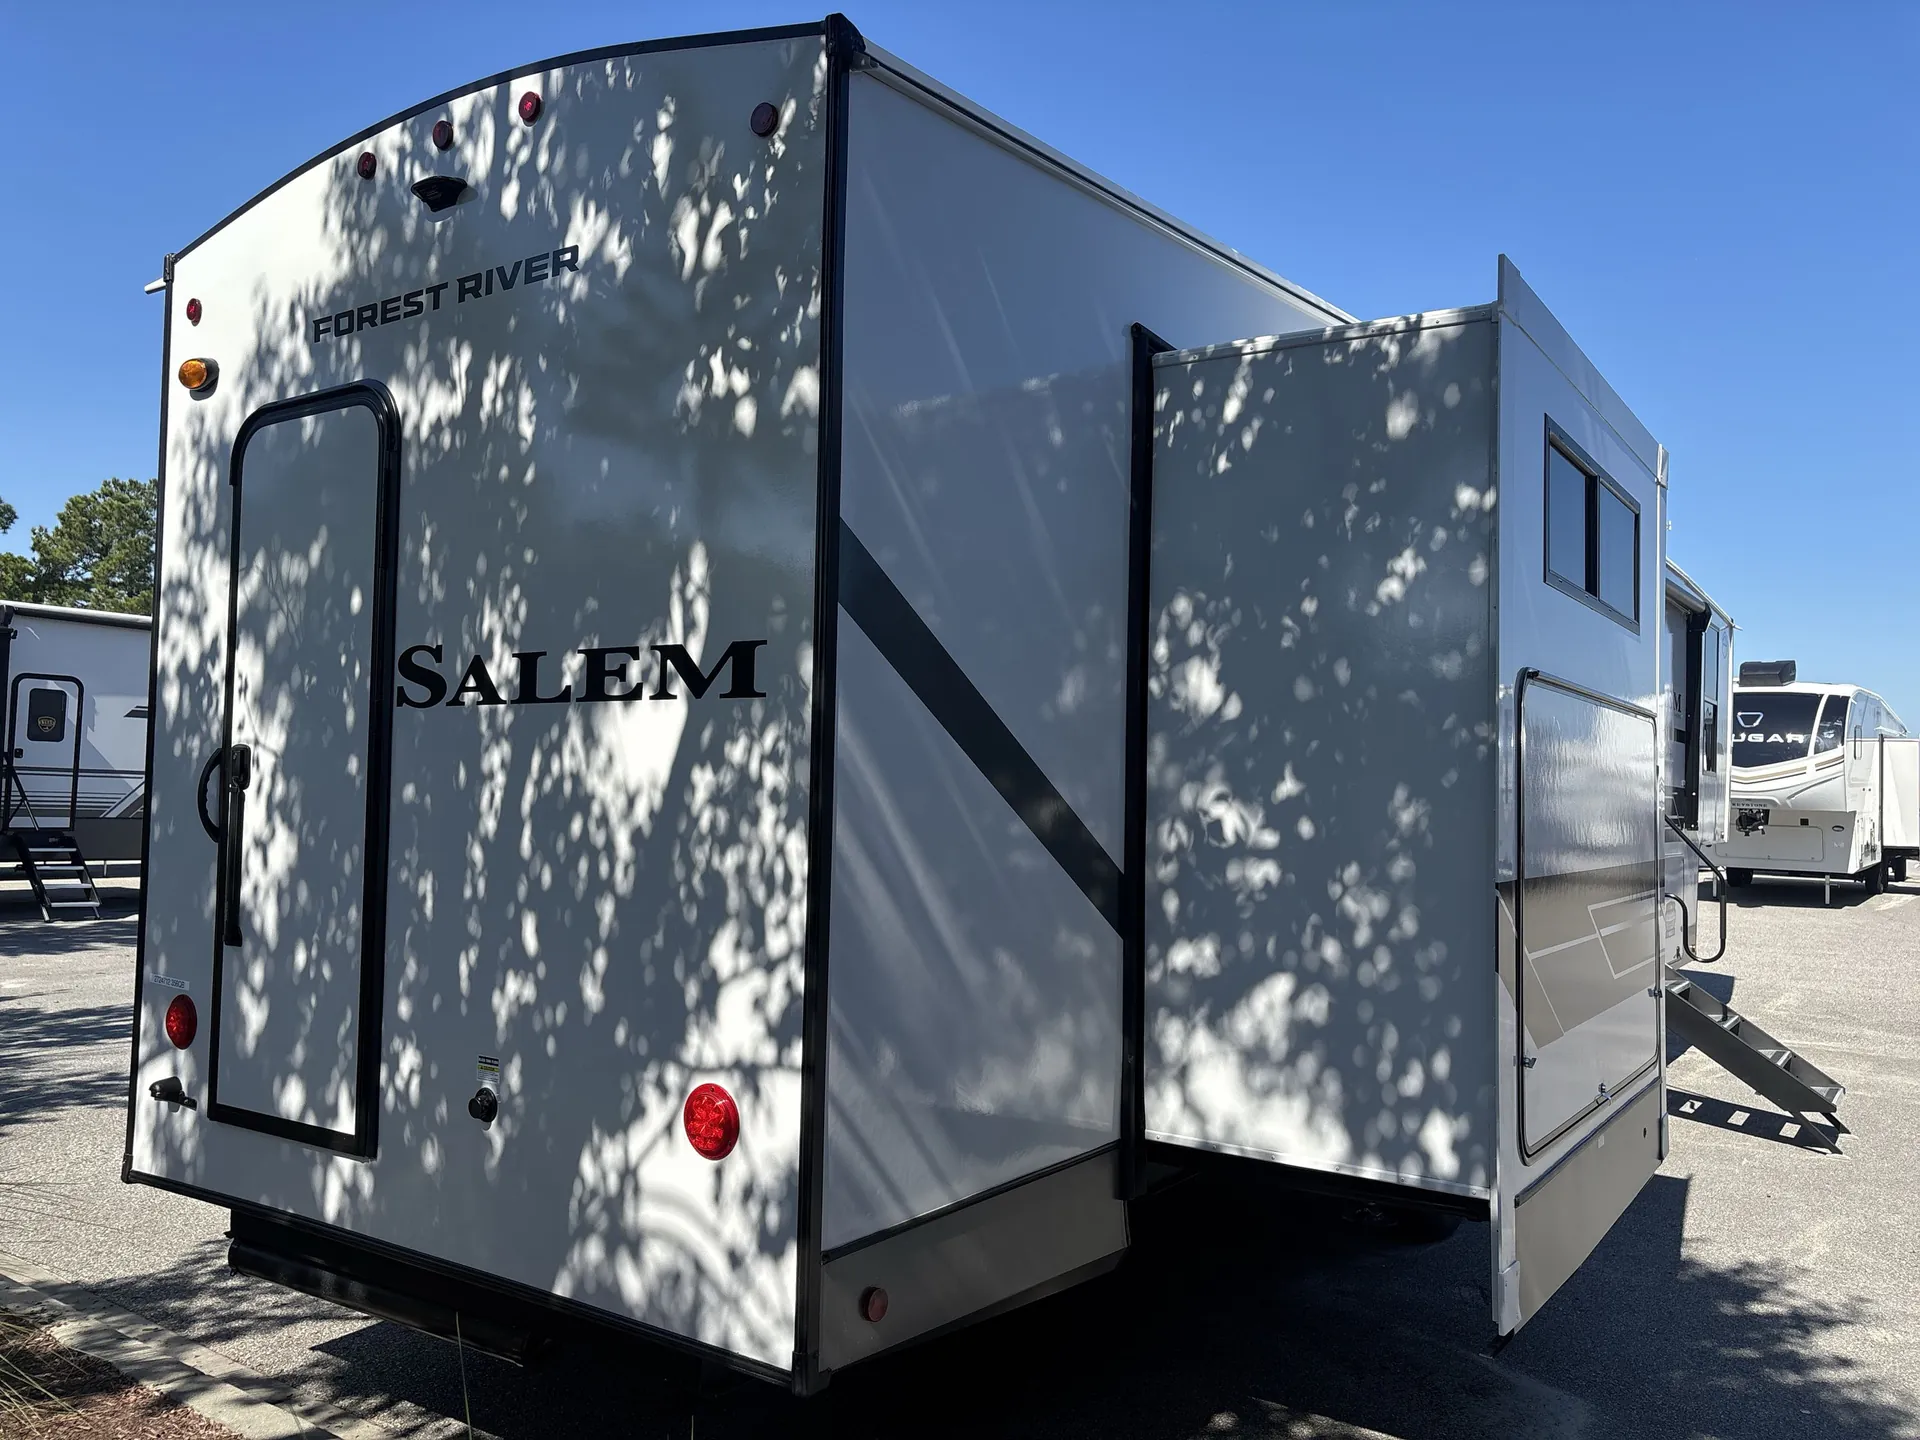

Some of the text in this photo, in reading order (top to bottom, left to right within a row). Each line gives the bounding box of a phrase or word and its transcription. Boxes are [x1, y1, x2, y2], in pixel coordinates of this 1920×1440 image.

[312, 244, 579, 343] FOREST RIVER
[396, 639, 768, 709] SALEM
